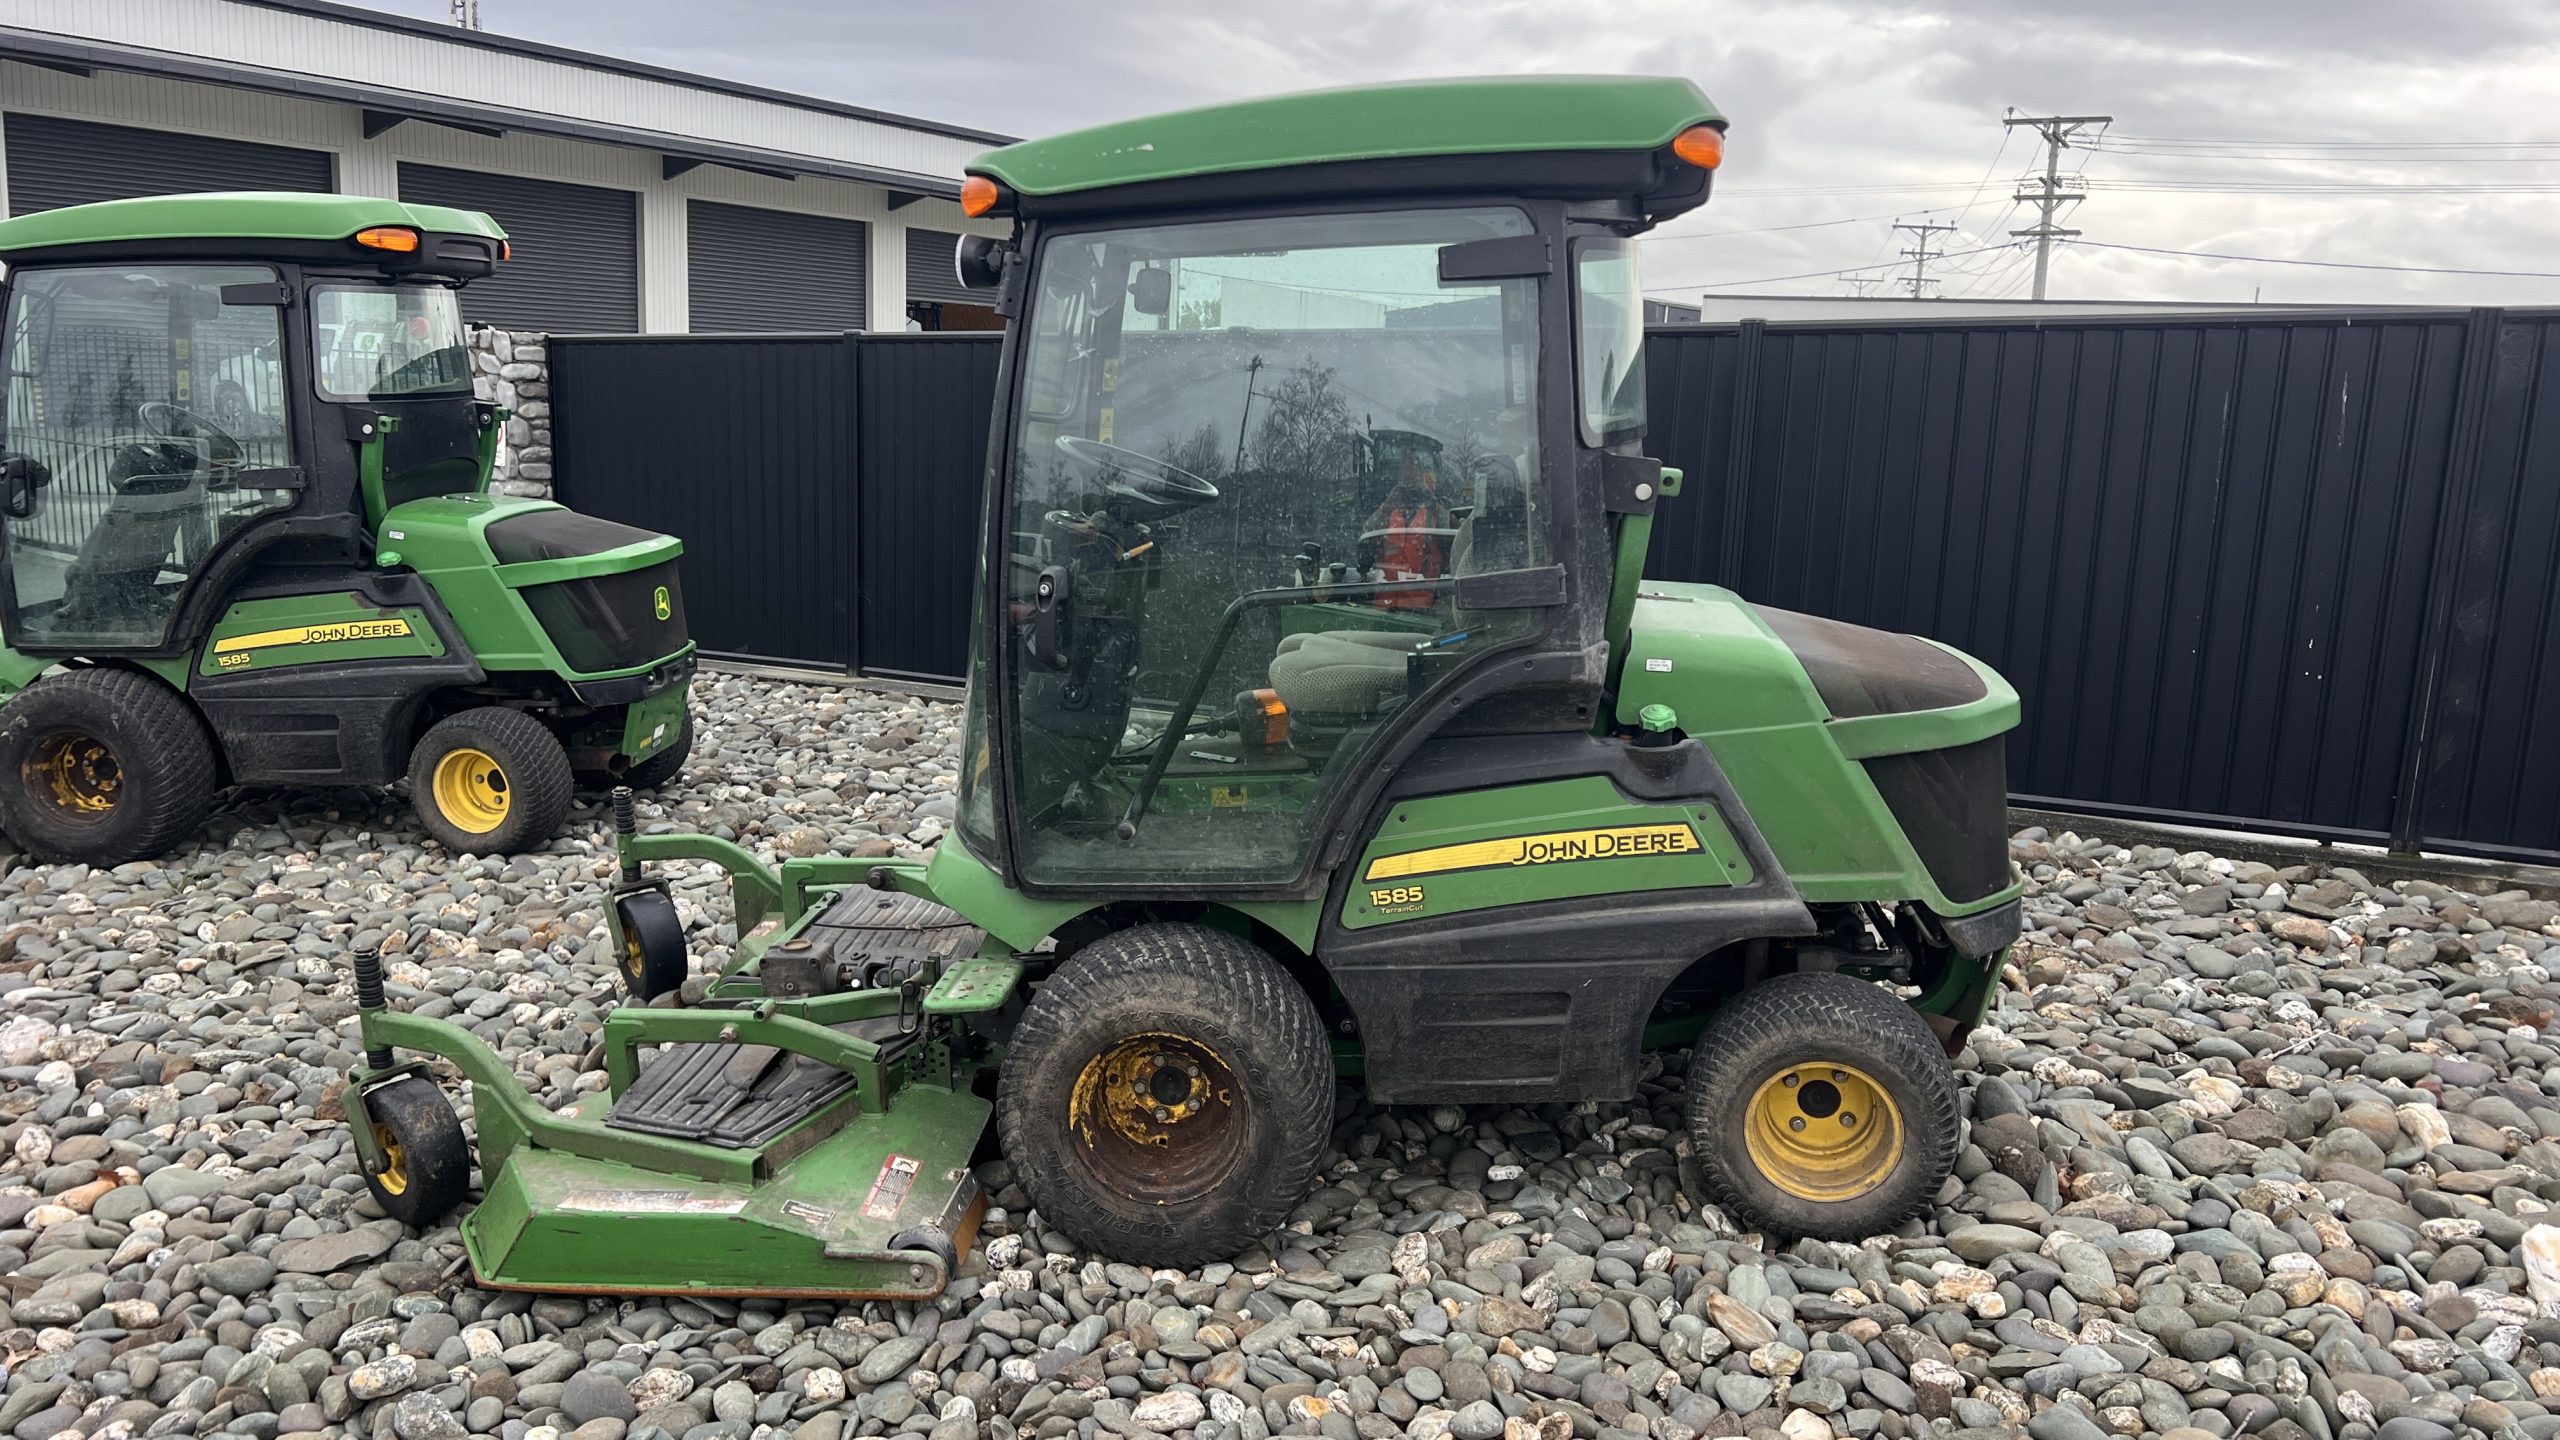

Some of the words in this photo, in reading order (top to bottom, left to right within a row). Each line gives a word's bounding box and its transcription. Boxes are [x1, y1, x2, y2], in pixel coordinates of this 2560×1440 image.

[301, 628, 345, 641] JOHN
[349, 624, 402, 637] DEERE
[217, 653, 251, 667] 1585
[1513, 839, 1587, 862] JOHN
[1595, 833, 1685, 855] DEERE
[1369, 886, 1424, 906] 1585
[1381, 904, 1424, 914] TerrainCut
